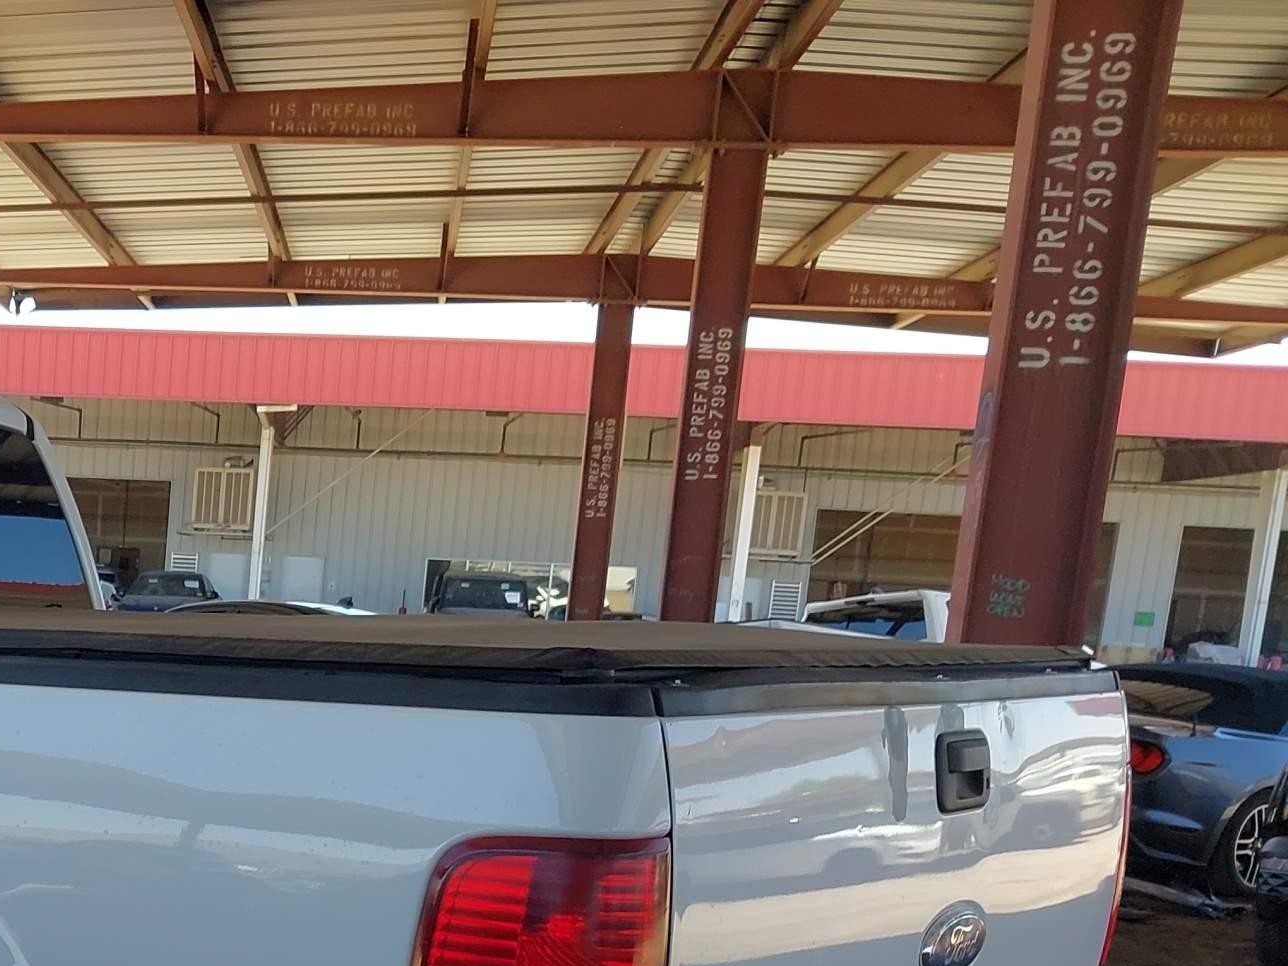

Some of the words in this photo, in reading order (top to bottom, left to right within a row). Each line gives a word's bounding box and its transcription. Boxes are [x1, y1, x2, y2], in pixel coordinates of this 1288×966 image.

[1055, 29, 1096, 103] INC.
[1033, 125, 1082, 273] PREFAB
[1059, 32, 1137, 366] 1-866-799-0969
[1018, 297, 1058, 368] U.S.
[689, 368, 711, 438] PREFAB
[702, 327, 734, 480] 1-866-799-0969
[587, 444, 603, 491] PREFAB
[595, 418, 616, 519] 1-866-799-0969
